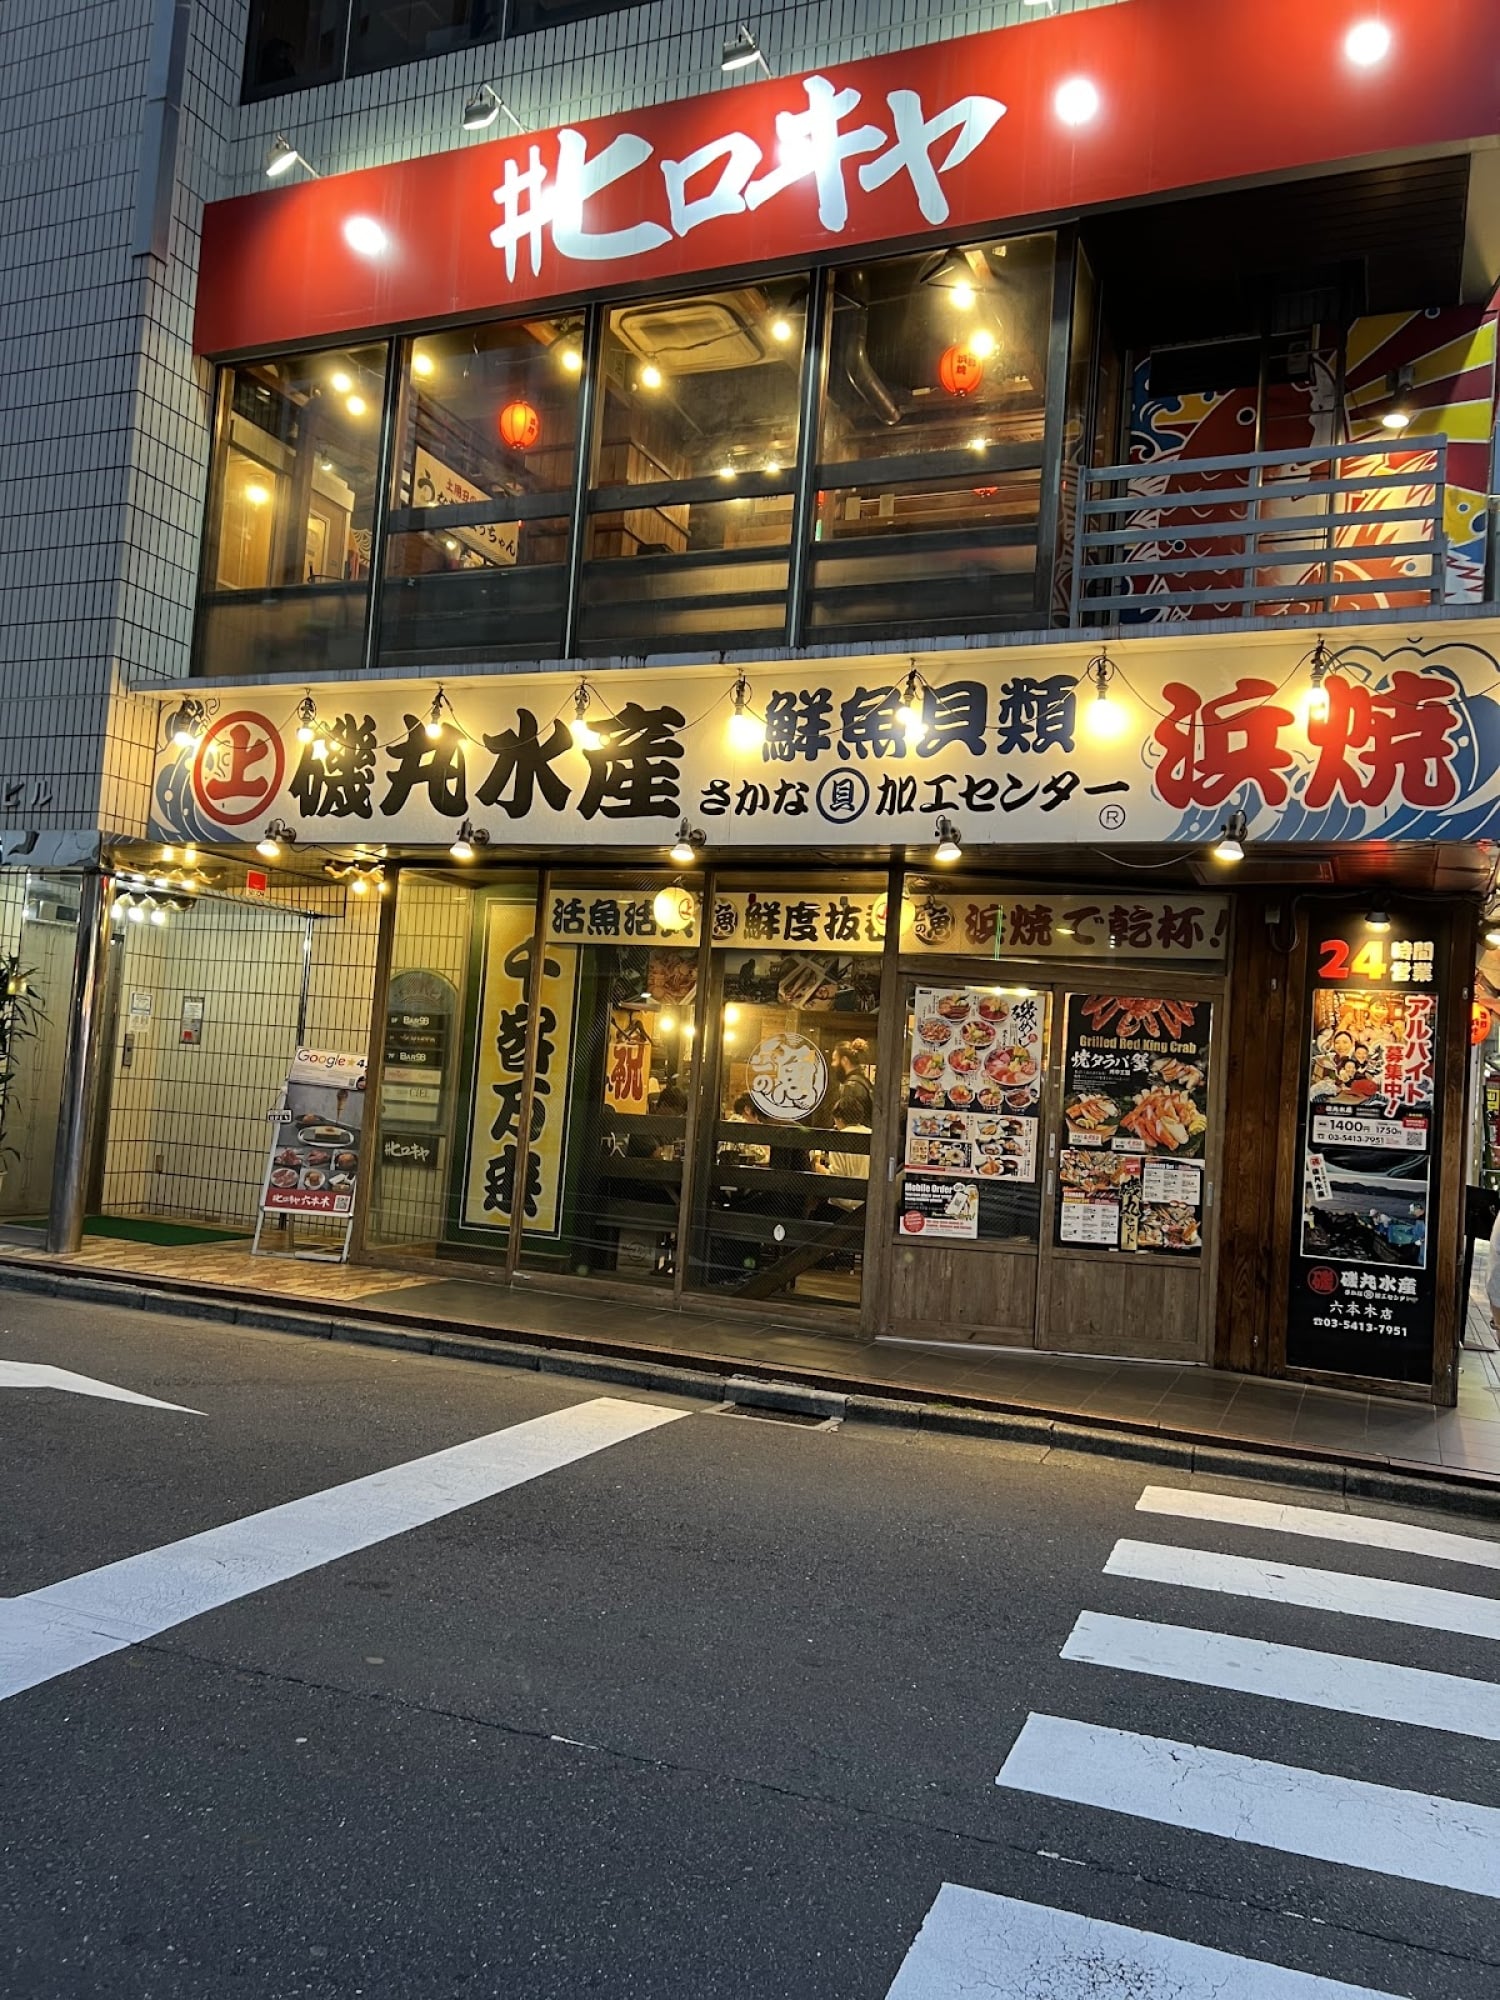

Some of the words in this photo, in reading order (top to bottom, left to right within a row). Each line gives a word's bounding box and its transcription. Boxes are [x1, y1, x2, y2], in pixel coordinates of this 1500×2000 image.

[762, 673, 1079, 763] 鮮魚貝類
[1154, 670, 1457, 809] 浜焼
[288, 702, 687, 820] 磯丸水産
[1318, 939, 1388, 980] 24
[1391, 940, 1434, 961] 時間
[1390, 961, 1433, 982] 営業
[1079, 1034, 1117, 1049] Grilled
[1119, 1037, 1141, 1051] Red
[1143, 1039, 1168, 1053] King
[1169, 1040, 1197, 1055] Crab
[1405, 995, 1434, 1105] アルバイト
[298, 1049, 346, 1068] Google
[611, 1045, 643, 1101] 祝
[1384, 1045, 1405, 1117] 募集中!
[904, 1182, 931, 1193] Mobile
[931, 1184, 952, 1194] Order
[1340, 1271, 1418, 1296] 磯丸水産
[1329, 1300, 1394, 1321] 六本木店
[1323, 1317, 1408, 1337] 03-5413-7951
